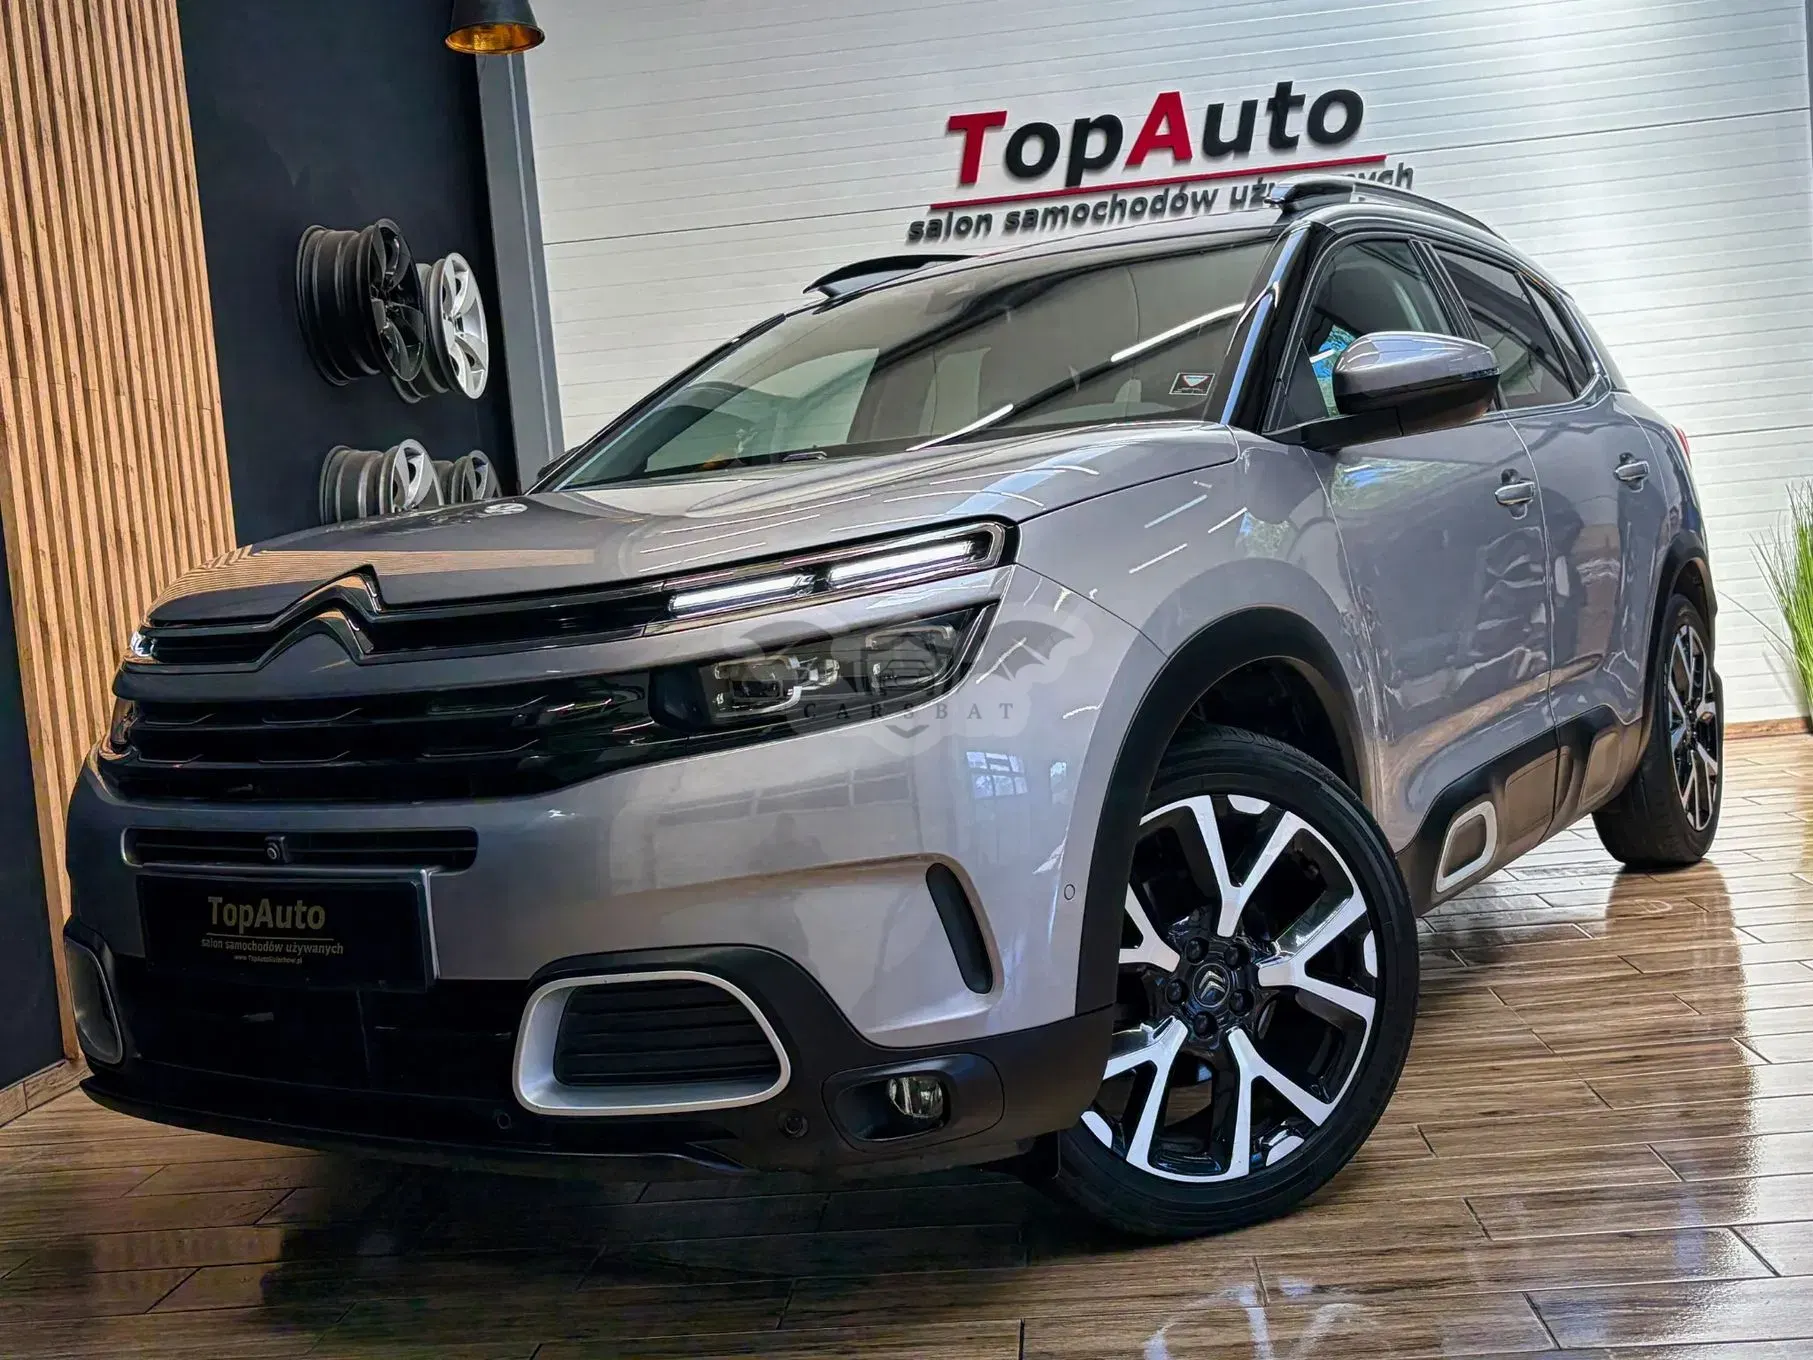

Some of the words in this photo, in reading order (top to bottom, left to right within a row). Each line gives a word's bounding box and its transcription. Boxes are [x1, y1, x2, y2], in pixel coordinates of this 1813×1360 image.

[947, 80, 1364, 188] TopAuto
[908, 211, 993, 241] salon
[1004, 184, 1219, 231] samochodów
[207, 896, 326, 934] TopAuto
[201, 937, 223, 949] salon
[225, 939, 284, 953] samochodów
[286, 941, 344, 956] używanych
